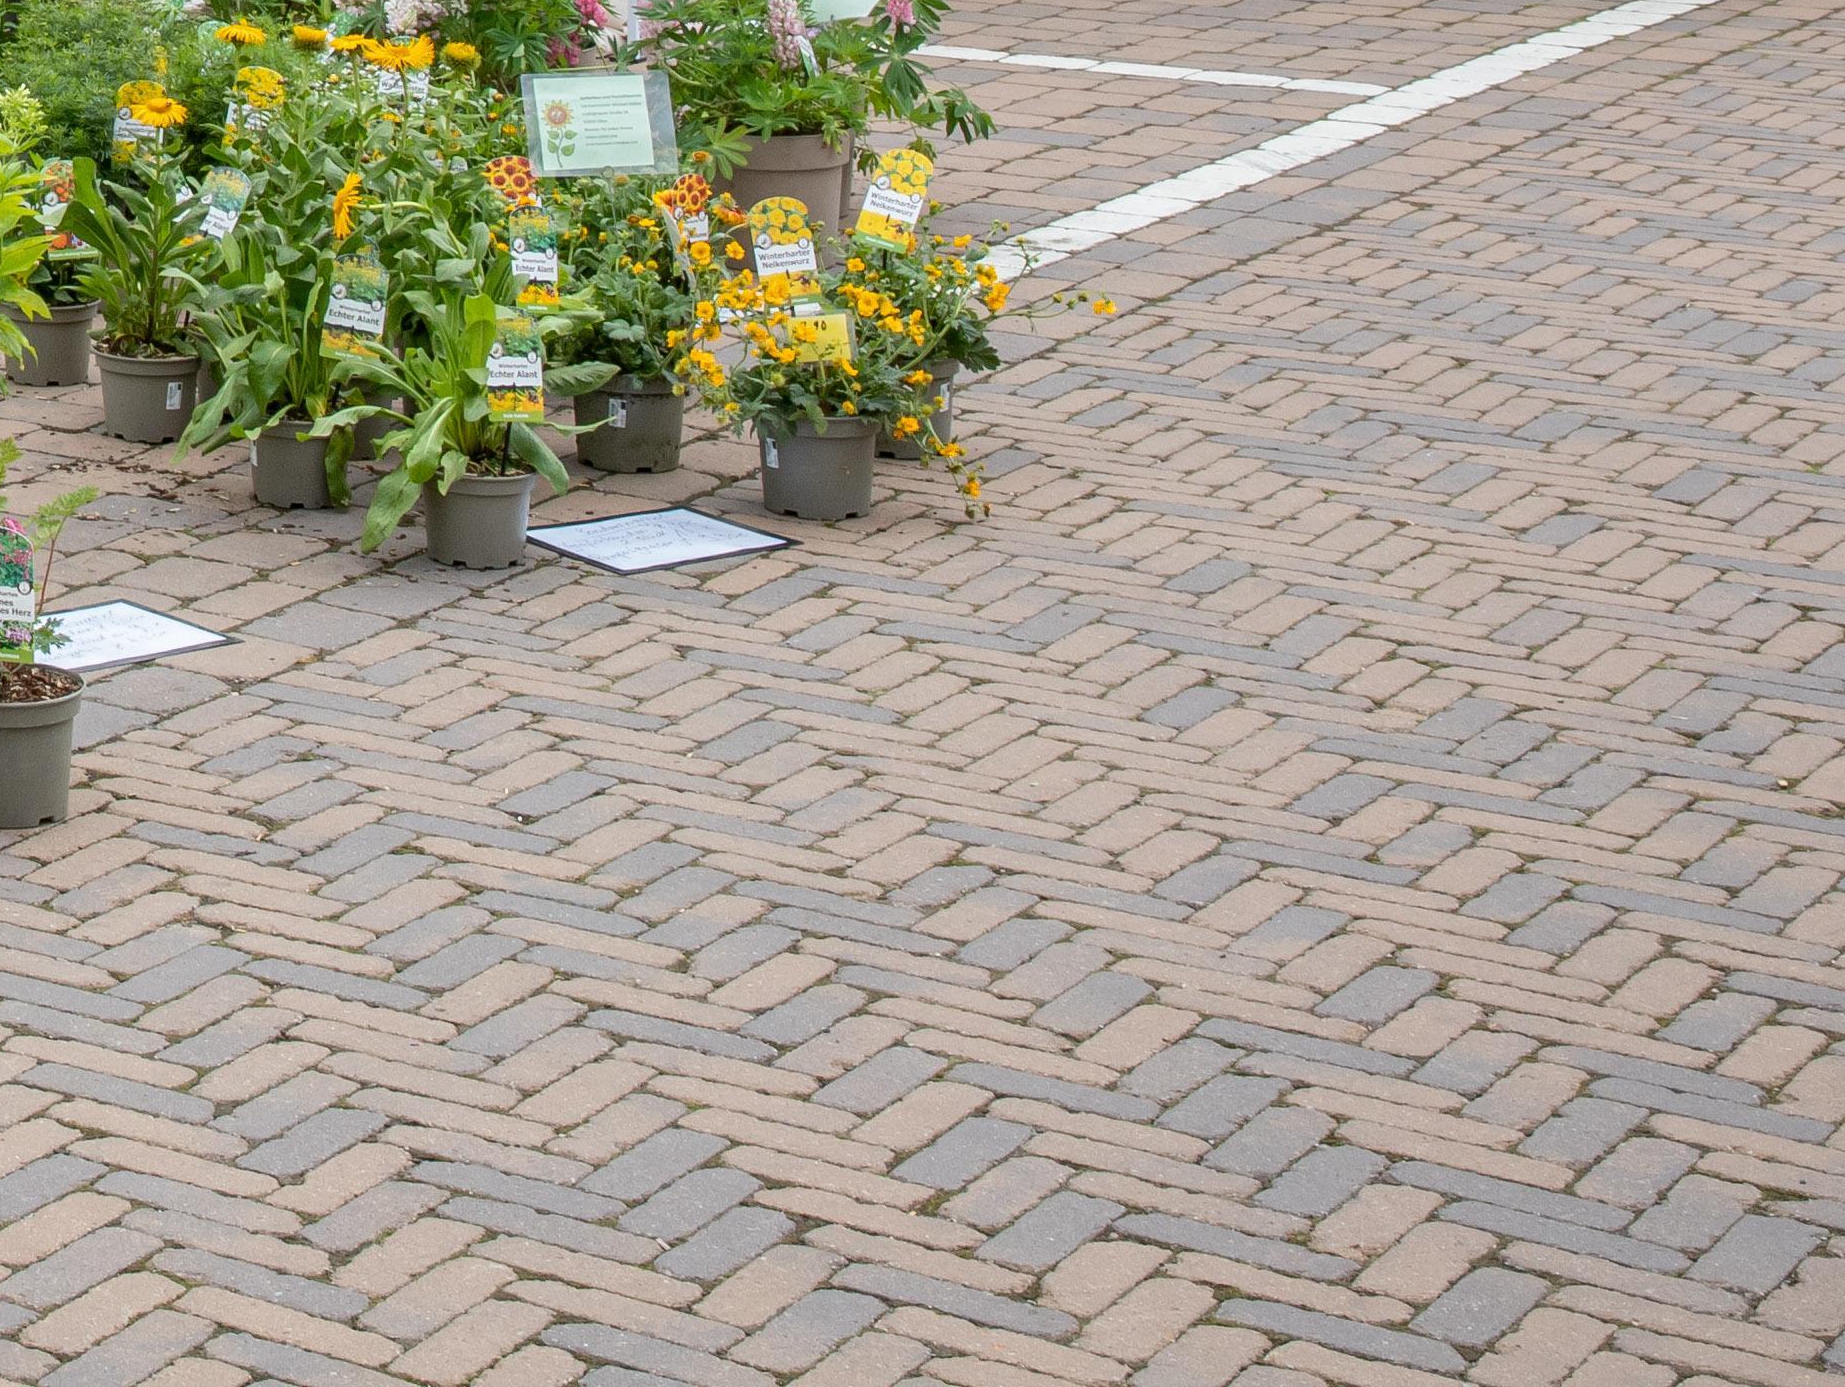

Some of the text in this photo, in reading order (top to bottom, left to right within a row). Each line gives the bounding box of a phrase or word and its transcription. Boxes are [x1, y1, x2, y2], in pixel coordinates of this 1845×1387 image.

[758, 249, 810, 261] Winterharter
[762, 258, 810, 270] Nelkenwurz
[329, 308, 379, 326] Echter Alant
[12, 607, 31, 617] Herz
